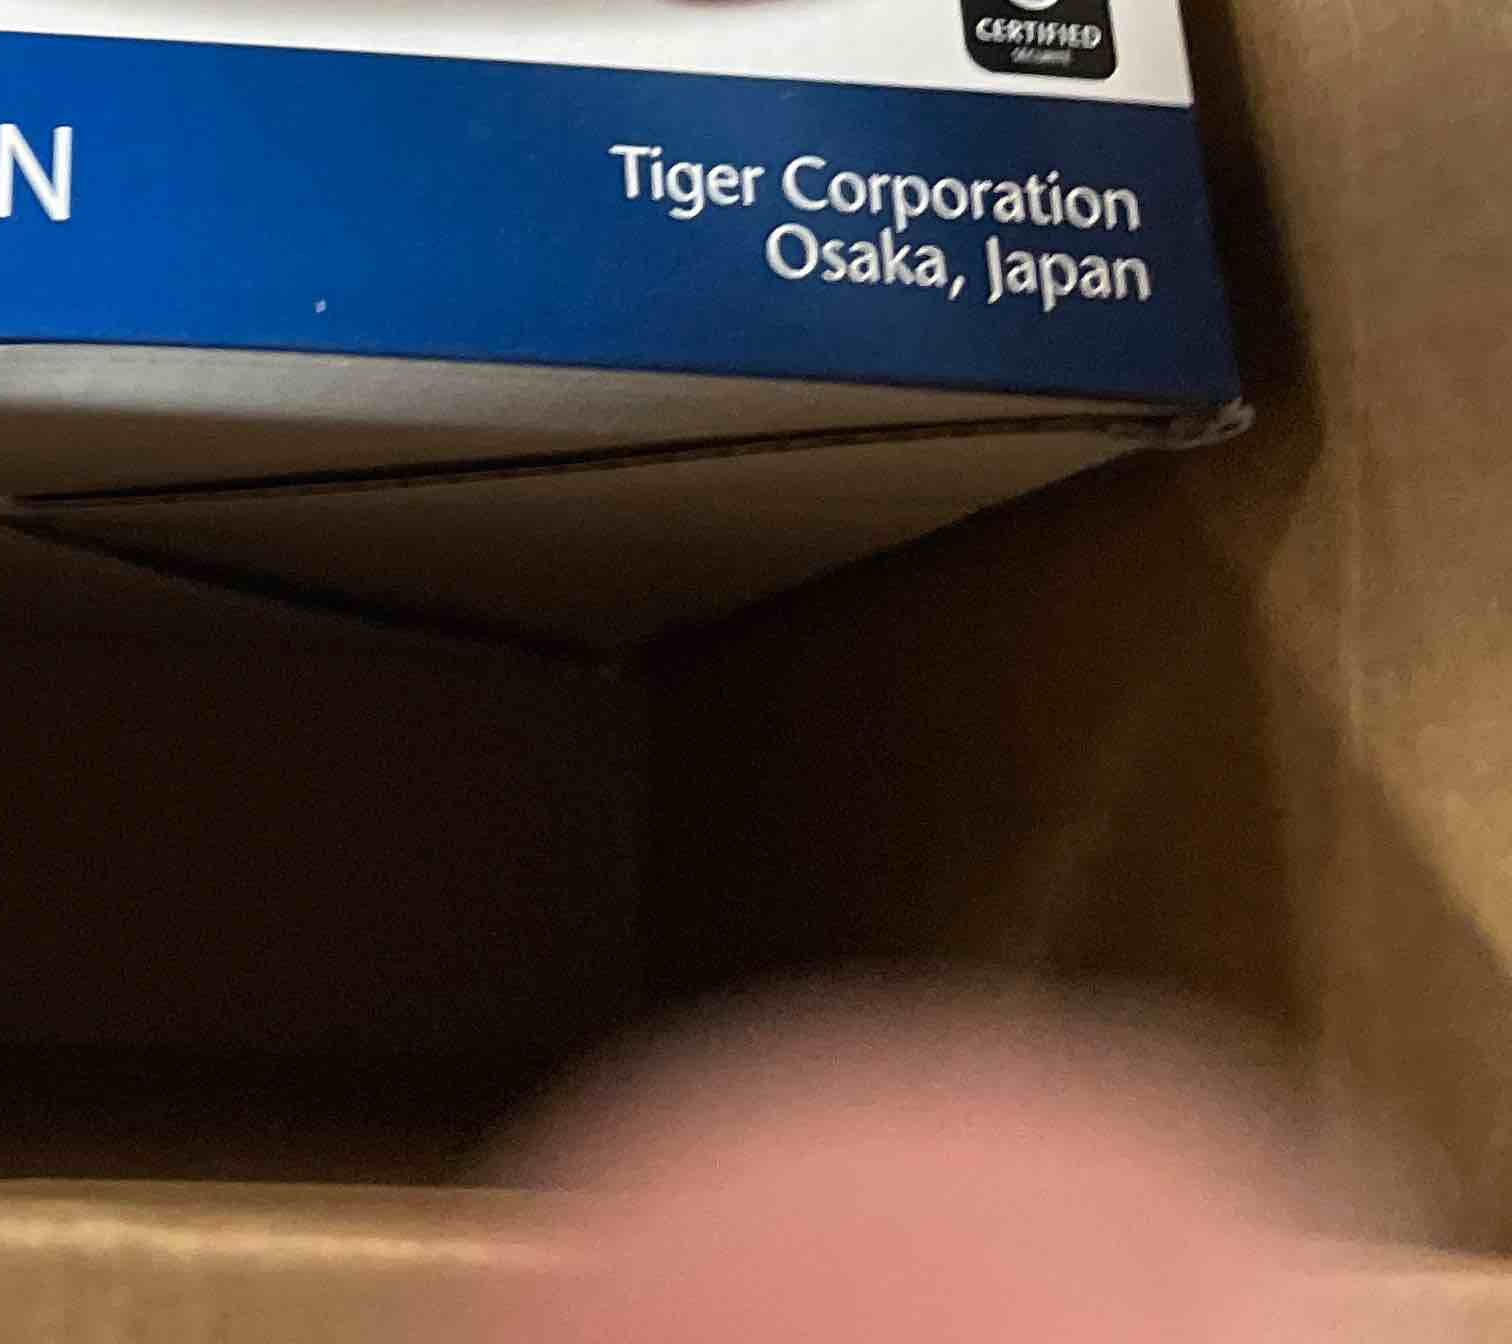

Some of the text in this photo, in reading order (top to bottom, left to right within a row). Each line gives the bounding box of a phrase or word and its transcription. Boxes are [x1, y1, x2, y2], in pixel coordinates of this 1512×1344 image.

[975, 16, 1103, 50] CERTIFIED
[608, 144, 1142, 234] Tiger Corporation
[765, 222, 1152, 313] Osaka, Japan
